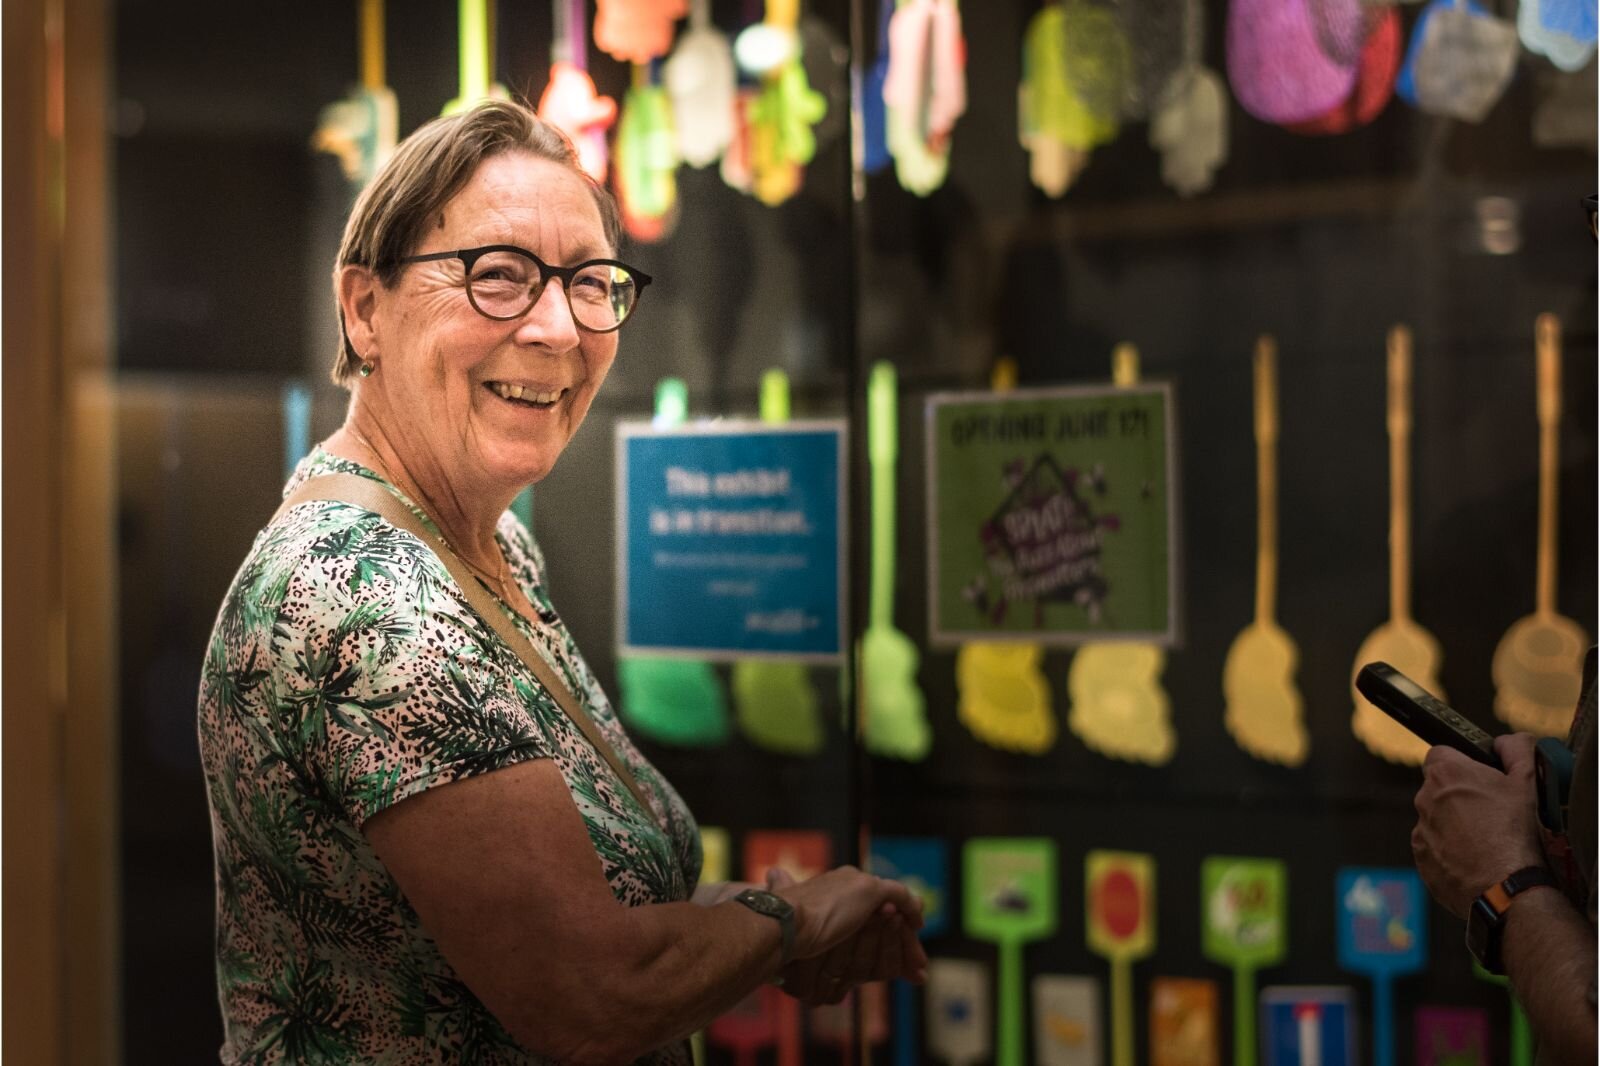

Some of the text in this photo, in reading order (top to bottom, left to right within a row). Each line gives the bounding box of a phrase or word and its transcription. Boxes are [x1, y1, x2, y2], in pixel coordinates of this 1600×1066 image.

[952, 410, 1046, 447] OPENING
[1056, 409, 1110, 441] JUNE
[667, 466, 790, 496] This exhibit
